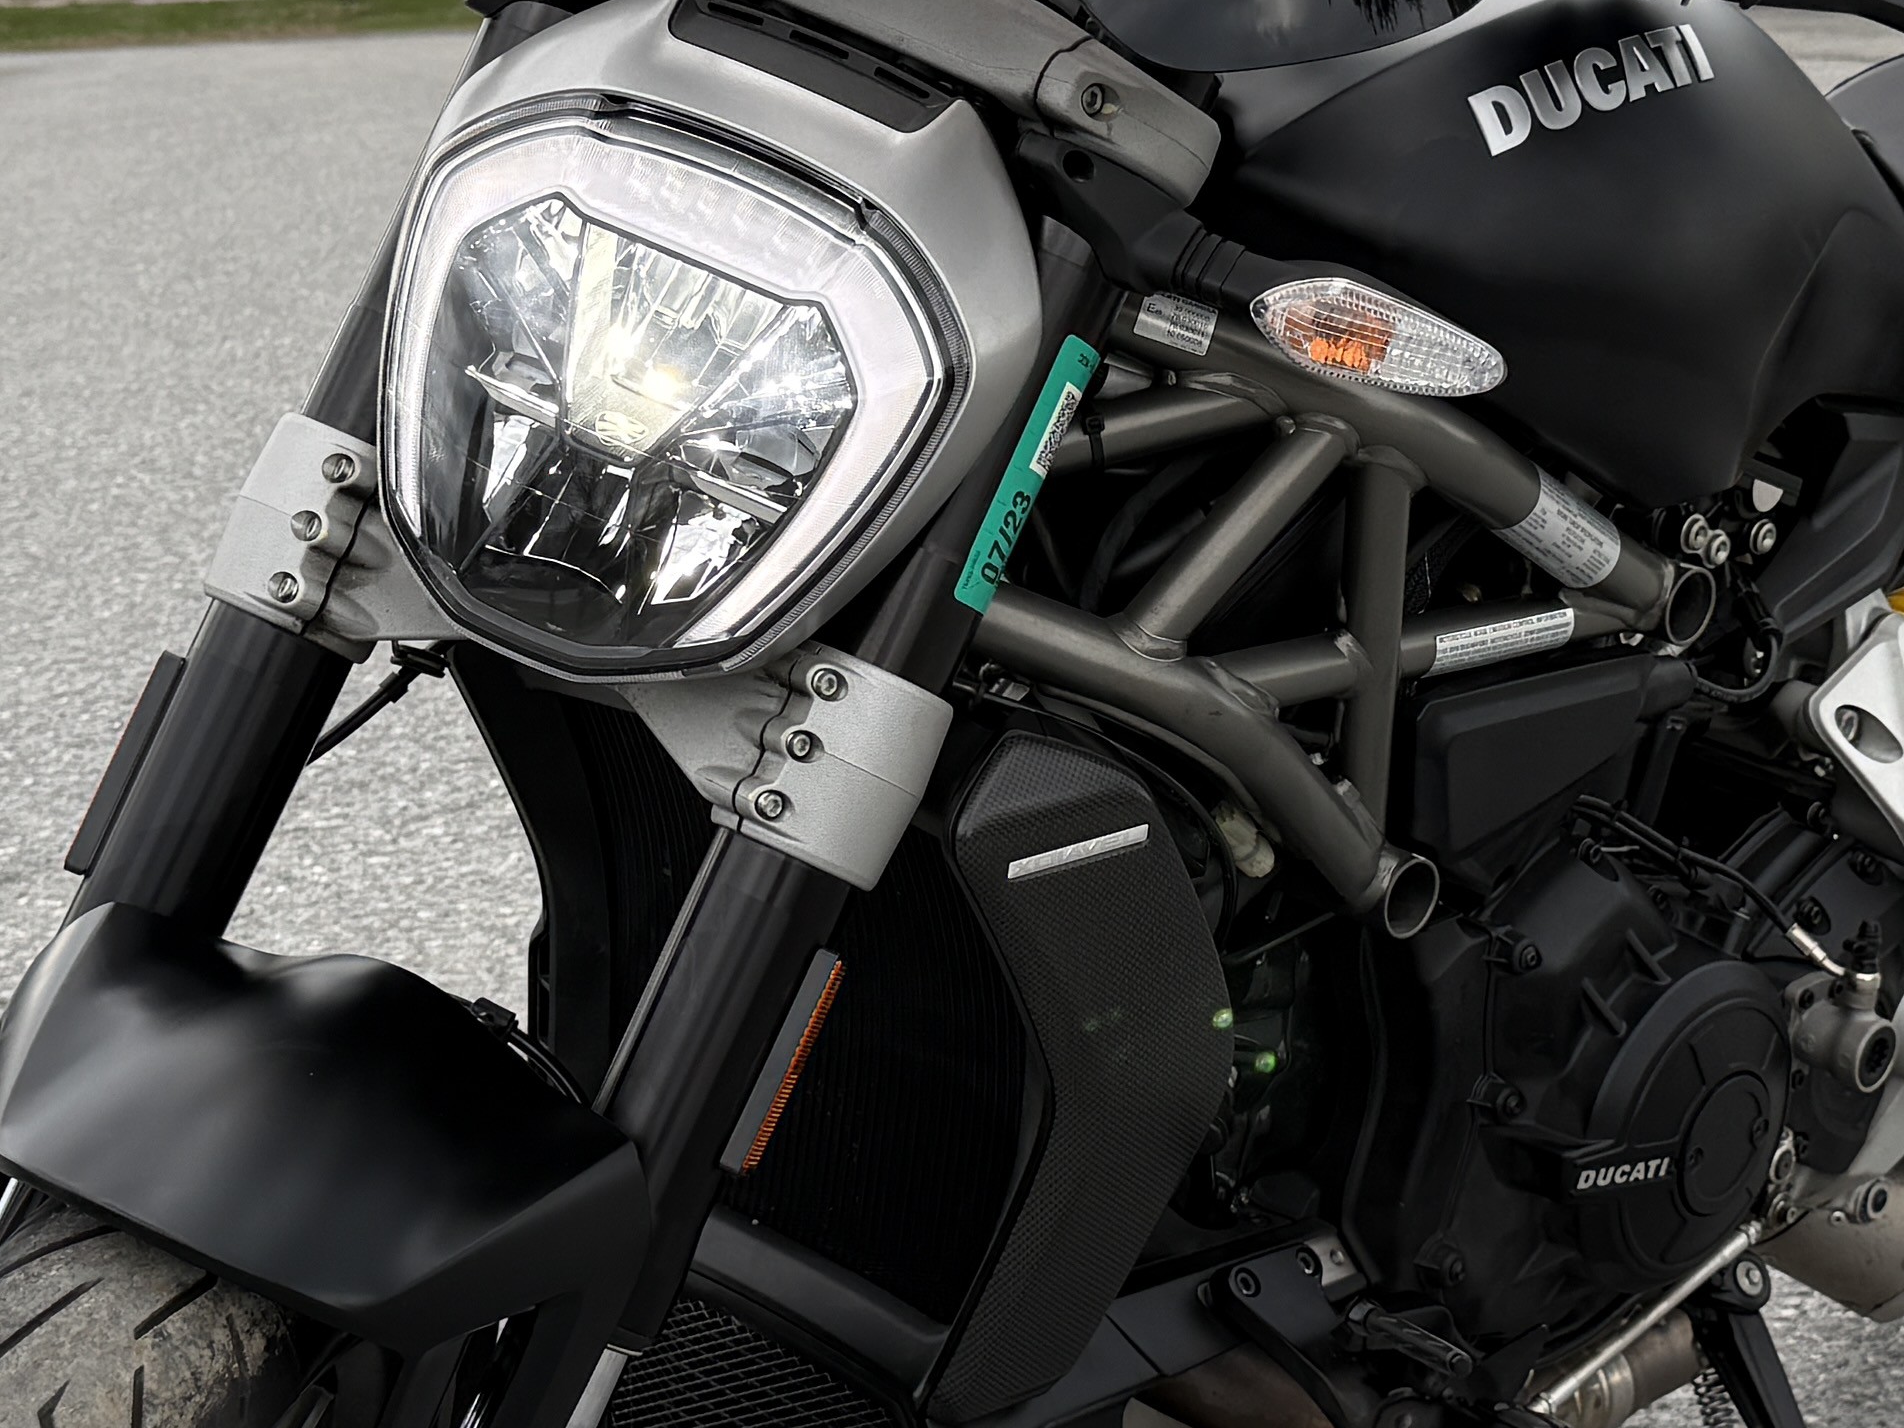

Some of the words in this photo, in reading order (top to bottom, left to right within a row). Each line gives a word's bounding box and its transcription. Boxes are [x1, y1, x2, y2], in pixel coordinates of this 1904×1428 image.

[1467, 24, 1715, 157] DUCATI
[980, 490, 1032, 586] 07/23
[1576, 1156, 1670, 1190] DUCATI
